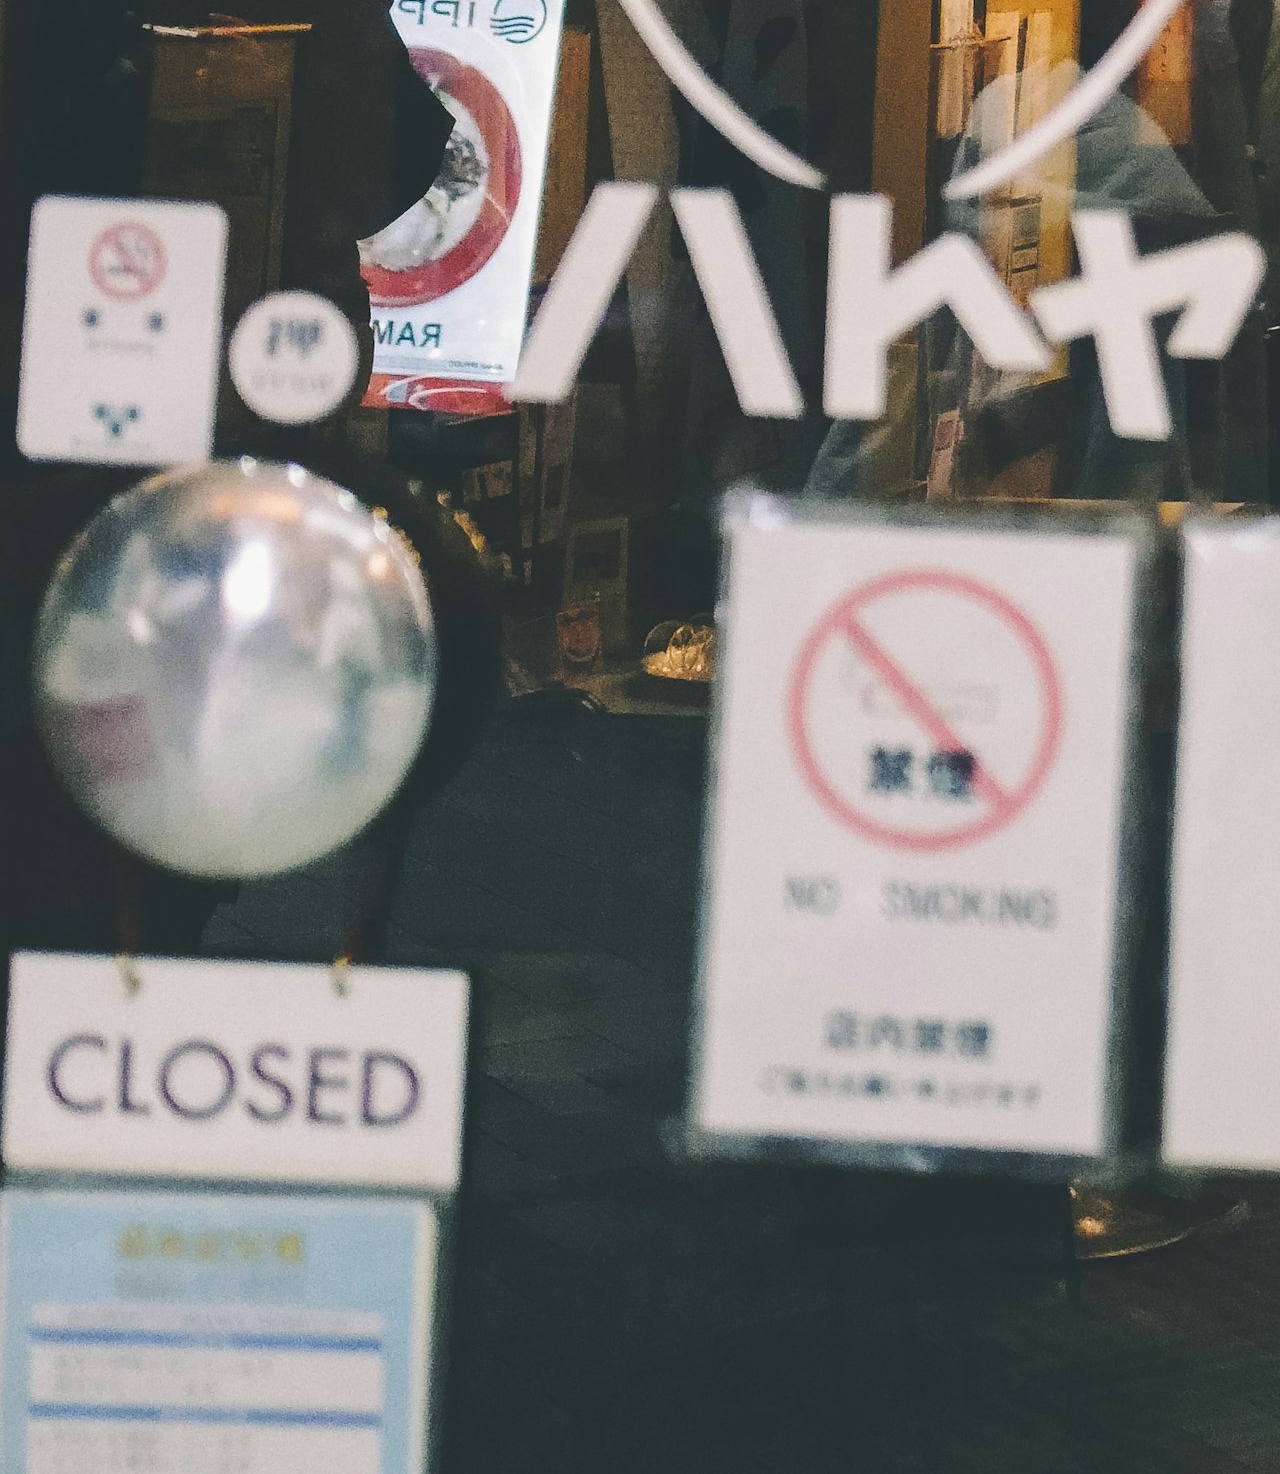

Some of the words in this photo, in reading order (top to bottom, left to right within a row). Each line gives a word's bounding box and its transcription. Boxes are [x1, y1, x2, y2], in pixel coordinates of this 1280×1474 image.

[784, 874, 840, 916] NO
[880, 878, 1057, 934] SMOKING
[47, 1033, 422, 1127] CLOSED
